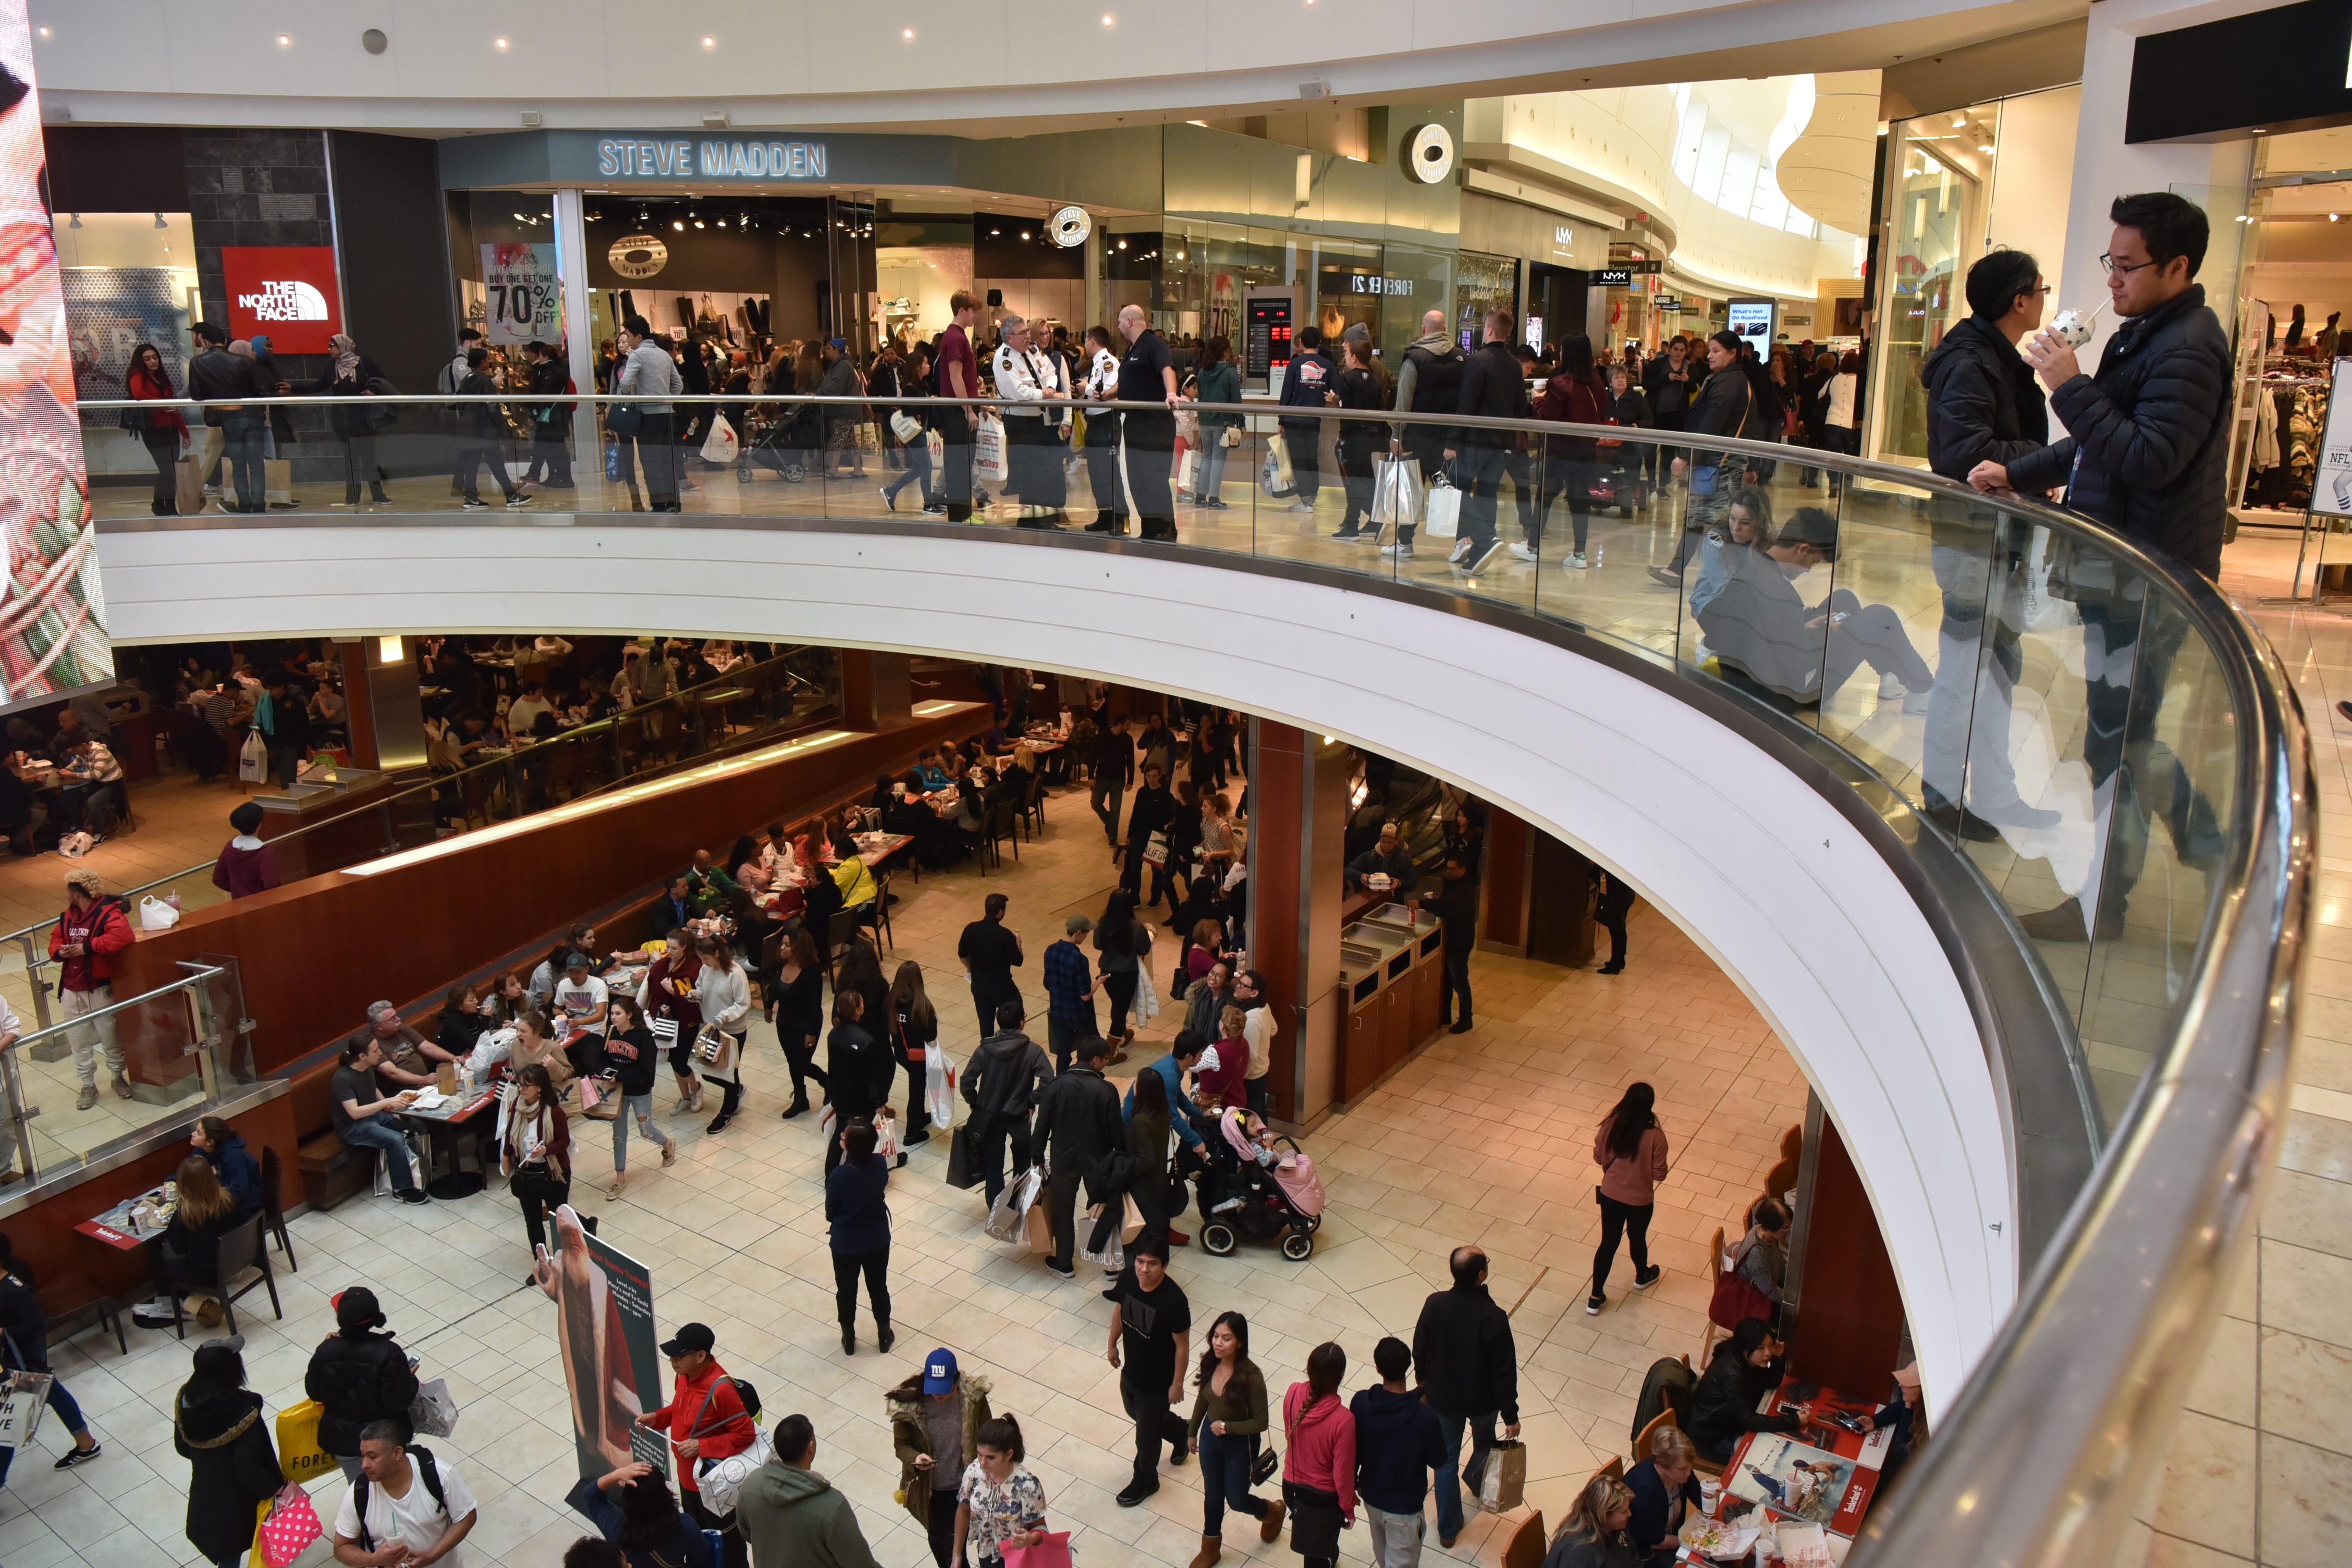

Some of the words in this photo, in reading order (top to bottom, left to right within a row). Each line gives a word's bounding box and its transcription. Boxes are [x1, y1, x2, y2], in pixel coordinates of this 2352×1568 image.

[598, 139, 693, 175] STEVE
[701, 142, 826, 177] MADDEN
[1059, 210, 1081, 223] STEVE
[1058, 226, 1087, 244] MADDEN
[1555, 226, 1573, 246] NYX
[489, 275, 505, 284] BUY
[506, 275, 521, 284] ONE
[523, 274, 537, 283] GET
[539, 274, 554, 283] ONE
[1602, 272, 1626, 280] NYX
[262, 280, 296, 295] THE
[238, 293, 297, 308] NORTH
[489, 285, 556, 324] 70%
[256, 307, 299, 321] FACE
[1212, 308, 1239, 337] 70%
[2330, 452, 2350, 464] NFL
[674, 976, 692, 996] N
[607, 1279, 622, 1292] Macy's
[637, 1297, 649, 1308] Sushi
[616, 1278, 628, 1289] Level
[631, 1287, 637, 1295] by
[612, 1289, 629, 1304] Monday
[632, 1301, 651, 1318] Saturday
[931, 1365, 946, 1378] ny
[636, 1439, 643, 1448] My
[643, 1443, 654, 1455] Little
[654, 1451, 665, 1462] Pony
[639, 1434, 665, 1456] Transformers
[640, 1450, 650, 1458] with
[729, 1465, 742, 1477] LOFT
[1843, 1488, 1861, 1514] Timberland
